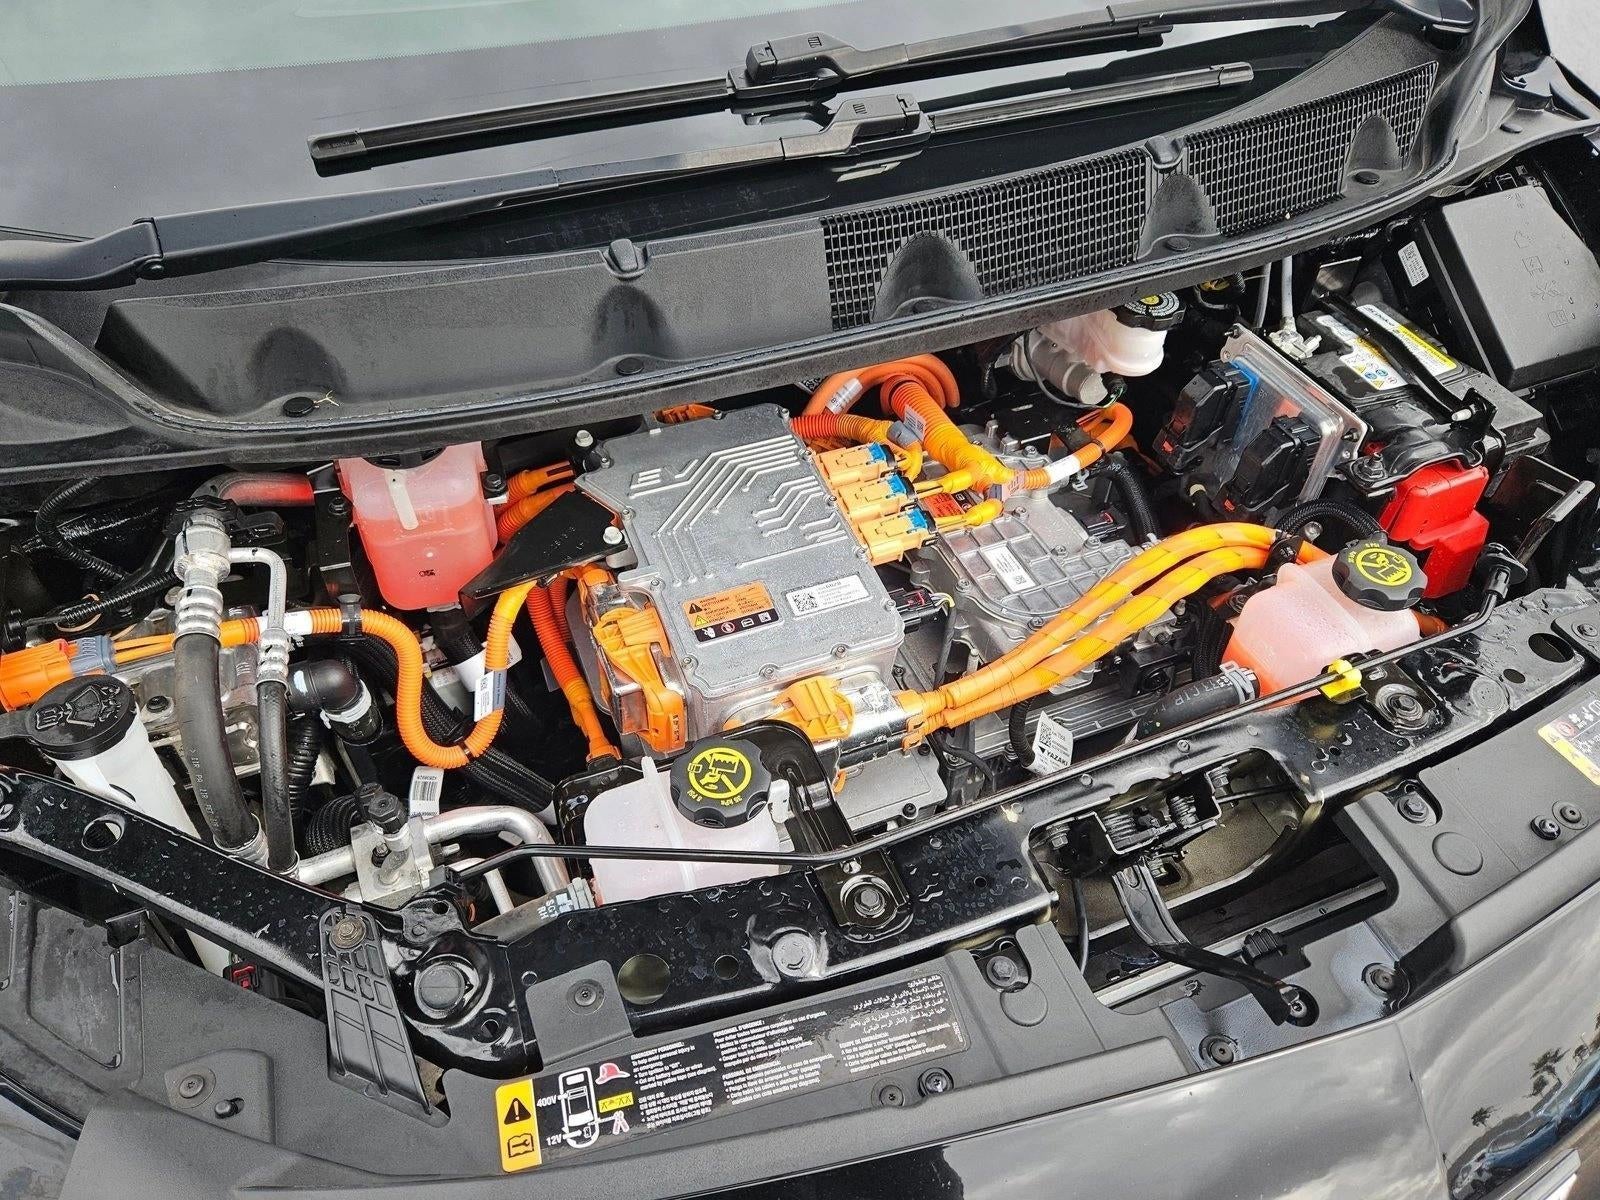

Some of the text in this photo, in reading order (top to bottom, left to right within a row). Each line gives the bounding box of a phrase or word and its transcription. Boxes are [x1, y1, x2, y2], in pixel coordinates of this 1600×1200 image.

[1047, 749, 1069, 766] YAZAKI
[537, 1095, 557, 1108] 400V
[545, 1134, 562, 1146] 12V
